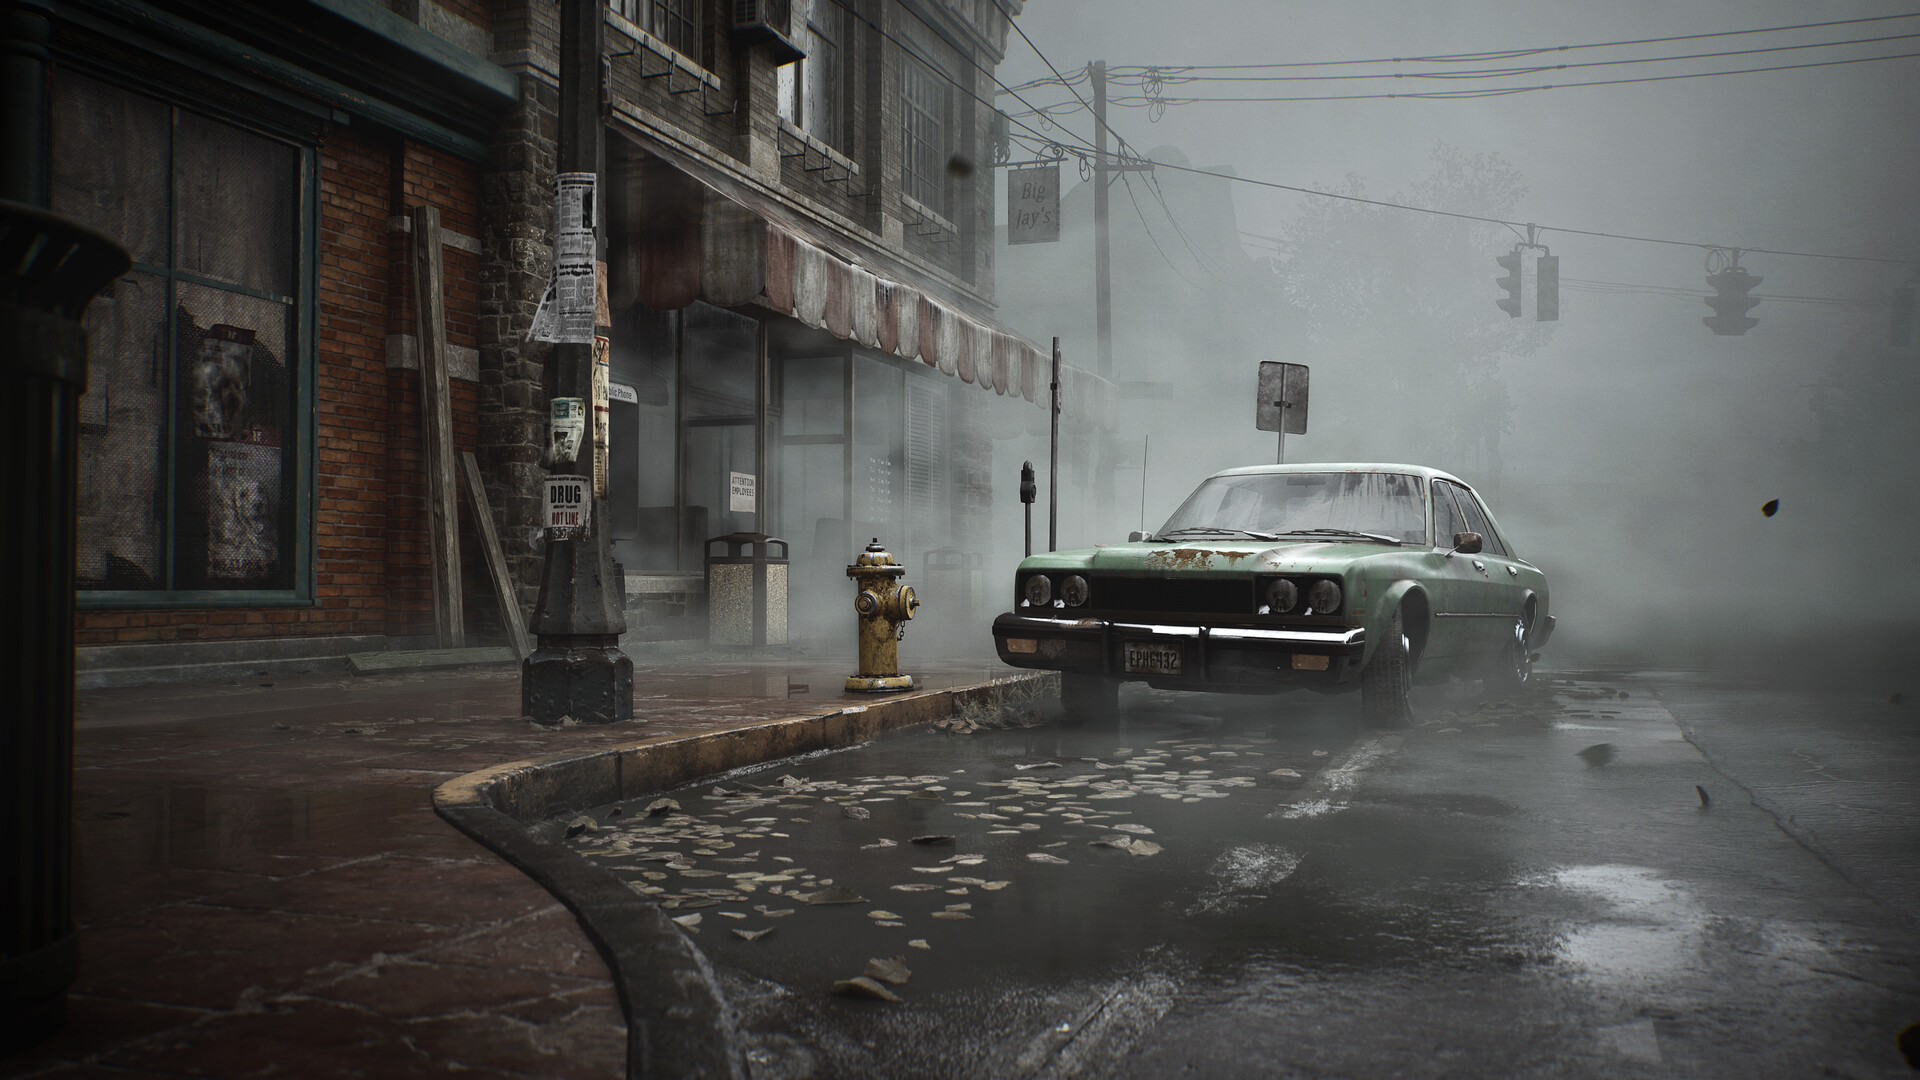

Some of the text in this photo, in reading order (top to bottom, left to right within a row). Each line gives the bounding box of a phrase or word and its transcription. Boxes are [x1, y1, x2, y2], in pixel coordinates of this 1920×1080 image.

[1021, 182, 1046, 203] Big
[1015, 206, 1052, 230] Jay's
[618, 388, 632, 400] Phone
[732, 476, 754, 486] ATTENTION
[550, 485, 581, 504] DRUG
[732, 486, 754, 496] EMPLOYEES
[551, 511, 579, 526] HOT LINE
